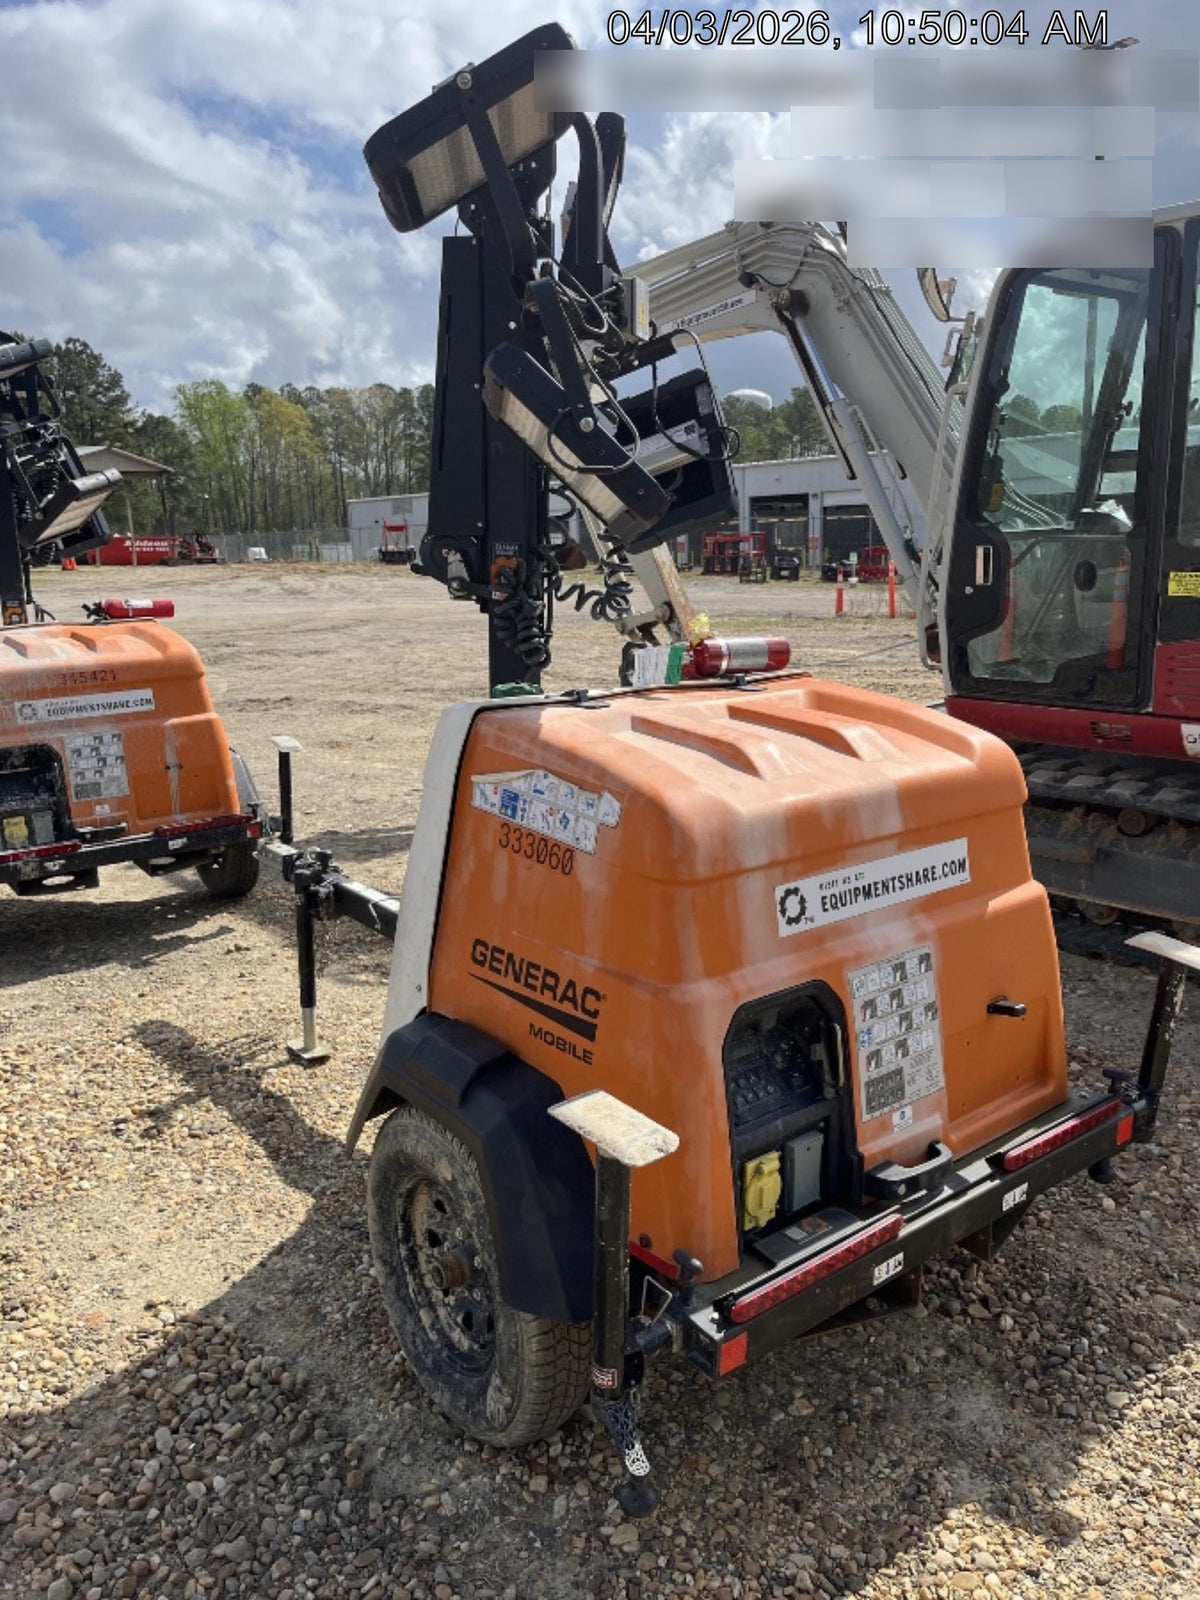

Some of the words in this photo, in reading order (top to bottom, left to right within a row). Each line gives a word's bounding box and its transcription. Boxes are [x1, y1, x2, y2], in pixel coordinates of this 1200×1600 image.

[499, 822, 574, 875] 333060
[821, 857, 967, 912] EQUIPMENTSHARE.COM
[471, 938, 601, 1019] GENERAC
[529, 1022, 593, 1066] MOBILE
